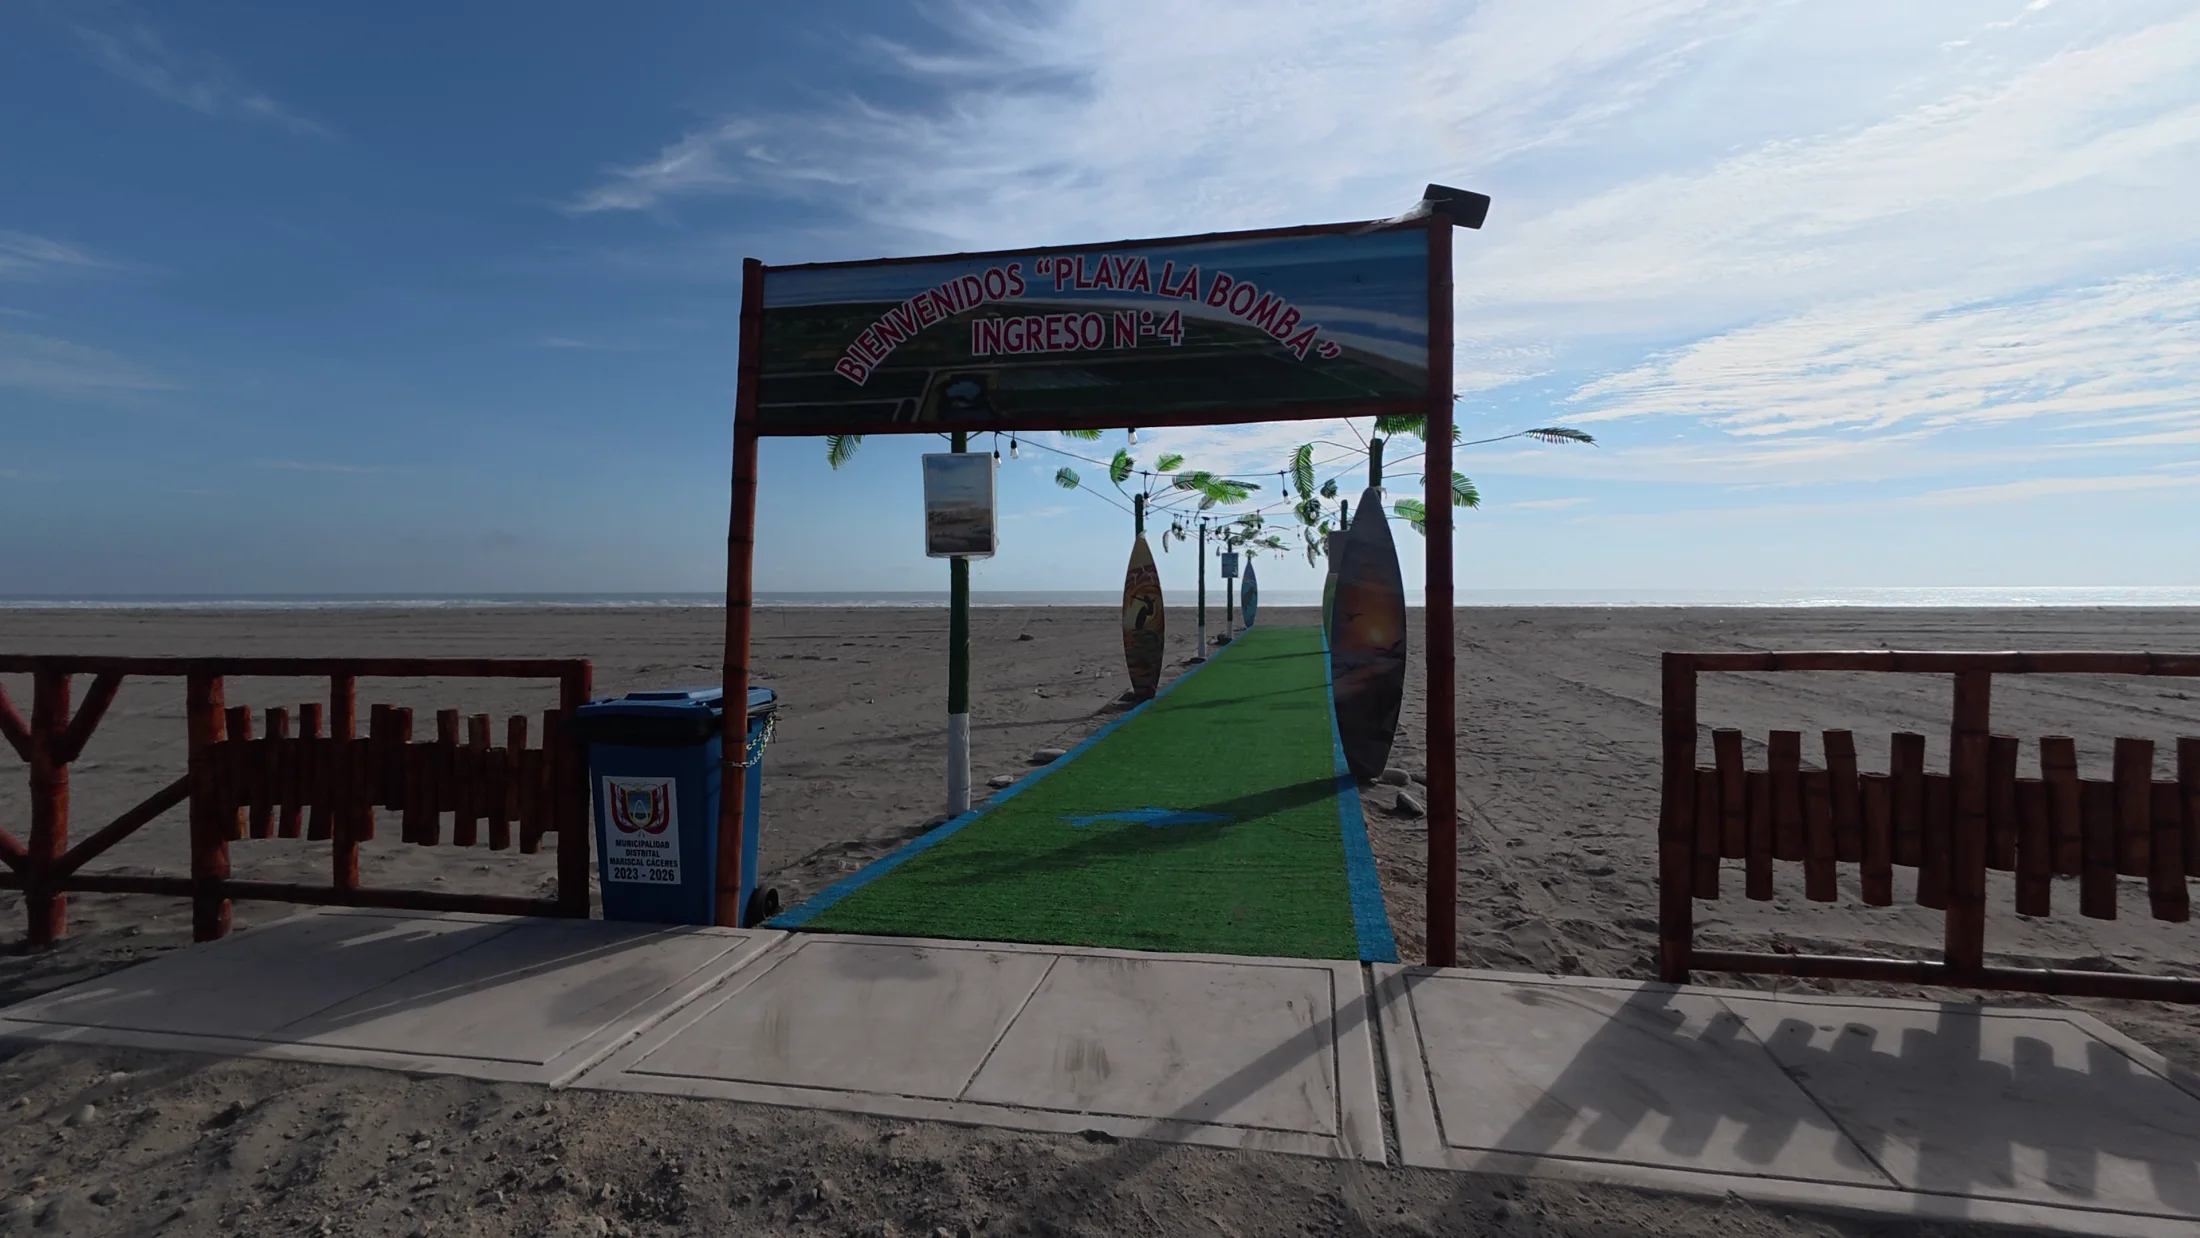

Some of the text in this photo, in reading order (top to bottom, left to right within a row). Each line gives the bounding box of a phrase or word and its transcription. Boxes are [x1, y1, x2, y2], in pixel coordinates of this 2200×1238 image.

[834, 262, 1025, 386] BIENVENIDOS
[1158, 260, 1200, 301] LA
[972, 311, 1106, 356] INGRESO
[615, 839, 670, 849] MUNICIPALIDAD
[625, 849, 661, 858] DISTRITAL
[609, 857, 644, 867] MARISCAL
[614, 867, 639, 880] 2023
[649, 868, 675, 881] 2026
